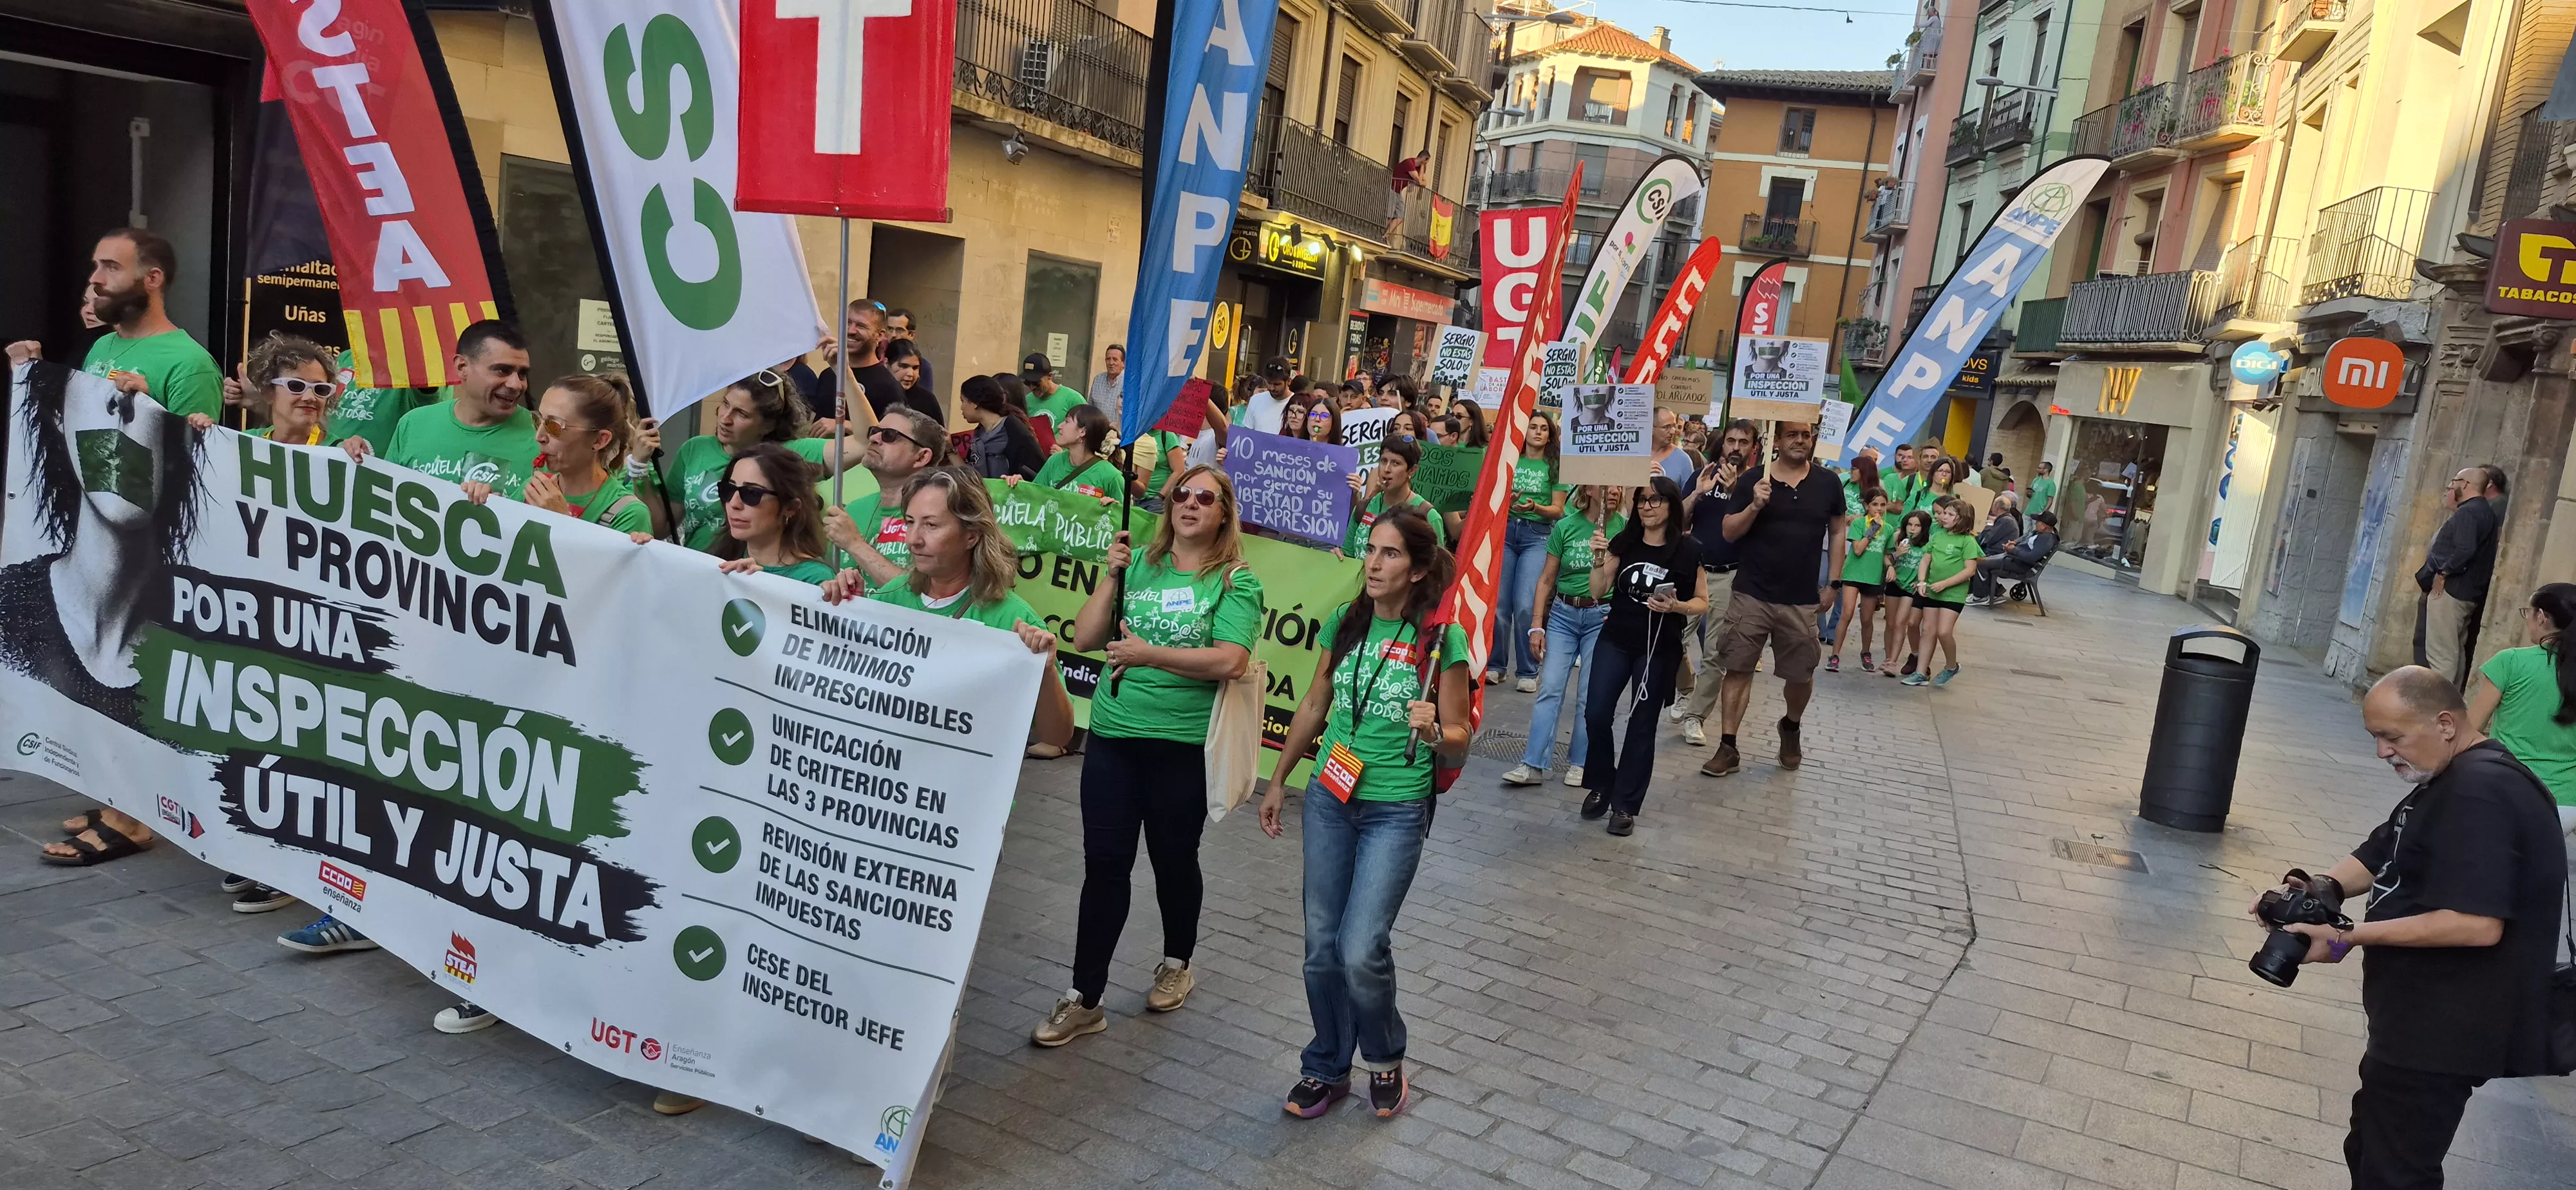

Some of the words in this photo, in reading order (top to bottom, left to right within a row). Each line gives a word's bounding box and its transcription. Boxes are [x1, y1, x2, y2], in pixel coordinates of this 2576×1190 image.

[1168, 0, 1255, 377] ANPE
[2005, 207, 2061, 235] ANPE
[1609, 240, 1619, 250] por
[1388, 289, 1401, 308] Mini
[1411, 293, 1444, 317] Supermercado
[285, 305, 327, 323] Uñas
[1217, 317, 1226, 334] 30
[1350, 320, 1365, 332] BEBIDAS
[1350, 331, 1362, 345] FRÍAS
[1442, 332, 1476, 348] SERGIO,
[1439, 359, 1463, 371] SOLO
[1441, 346, 1452, 357] NO
[1452, 348, 1472, 360] ESTÁS
[1545, 348, 1577, 363] SERGIO,
[1848, 243, 2022, 462] ANPE
[2235, 359, 2277, 370] DIGI
[1546, 364, 1556, 375] NO
[1556, 364, 1575, 375] ESTÁS
[1962, 375, 1979, 383] kids
[1747, 381, 1806, 391] INSPECCIÓN
[1575, 431, 1636, 444] INSPECCIÓN
[1579, 444, 1596, 453] ÚTIL
[1231, 435, 1255, 460] 10
[1262, 450, 1311, 469] meses
[1316, 455, 1337, 473] de
[471, 469, 501, 483] CSIF
[1234, 471, 1258, 486] por
[1264, 478, 1312, 495] ejercer
[1317, 489, 1333, 500] su
[1255, 461, 1316, 485] SANCIÓN
[1417, 464, 1470, 488] TAMOS
[1237, 486, 1303, 513] IBERTAD
[1312, 500, 1333, 517] DE
[237, 434, 568, 599] HUESCA
[236, 500, 269, 559] Y
[285, 517, 577, 668] PROVINCIA
[1051, 555, 1099, 596] EN
[1166, 599, 1192, 607] ANPE
[173, 576, 259, 639] POR
[273, 596, 366, 664] UNA
[791, 603, 933, 659] ELIMINACIÓN
[782, 634, 815, 661] DE
[817, 643, 915, 688] MÍNIMOS
[1383, 645, 1408, 656] CCOO
[1334, 672, 1354, 685] DE
[774, 664, 974, 735] IMPRESCINDIBLES
[23, 739, 42, 750] CSIF
[164, 648, 582, 832] INSPECCIÓN
[772, 713, 903, 771] UNIFICACIÓN
[770, 743, 792, 771] DE
[797, 753, 909, 806] CRITERIOS
[915, 786, 947, 814] EN
[1324, 768, 1350, 793] enseñanza
[1327, 757, 1356, 788] CCOO
[161, 796, 179, 814] CGT
[767, 773, 800, 806] LAS
[804, 789, 816, 812] 3
[822, 795, 960, 849] PROVINCIAS
[243, 755, 372, 855] ÚTIL
[383, 799, 424, 867] Y
[433, 819, 606, 939] JUSTA
[762, 822, 848, 874] REVISIÓN
[854, 859, 958, 902] EXTERNA
[322, 866, 352, 891] CCOO
[323, 885, 362, 913] enseñanza
[759, 851, 781, 880] DE
[784, 862, 820, 896] LAS
[825, 878, 954, 933] SANCIONES
[755, 880, 862, 941] IMPUESTAS
[446, 953, 475, 978] STEA
[746, 943, 791, 981] CESE
[795, 963, 833, 997] DEL
[742, 972, 849, 1032] INSPECTOR
[855, 1015, 905, 1052] JEFE
[591, 1017, 638, 1053] UGT
[671, 1053, 696, 1064] Aragón
[672, 1044, 712, 1060] Enseñanza
[670, 1062, 694, 1073] Servicios
[694, 1068, 715, 1078] Públicos
